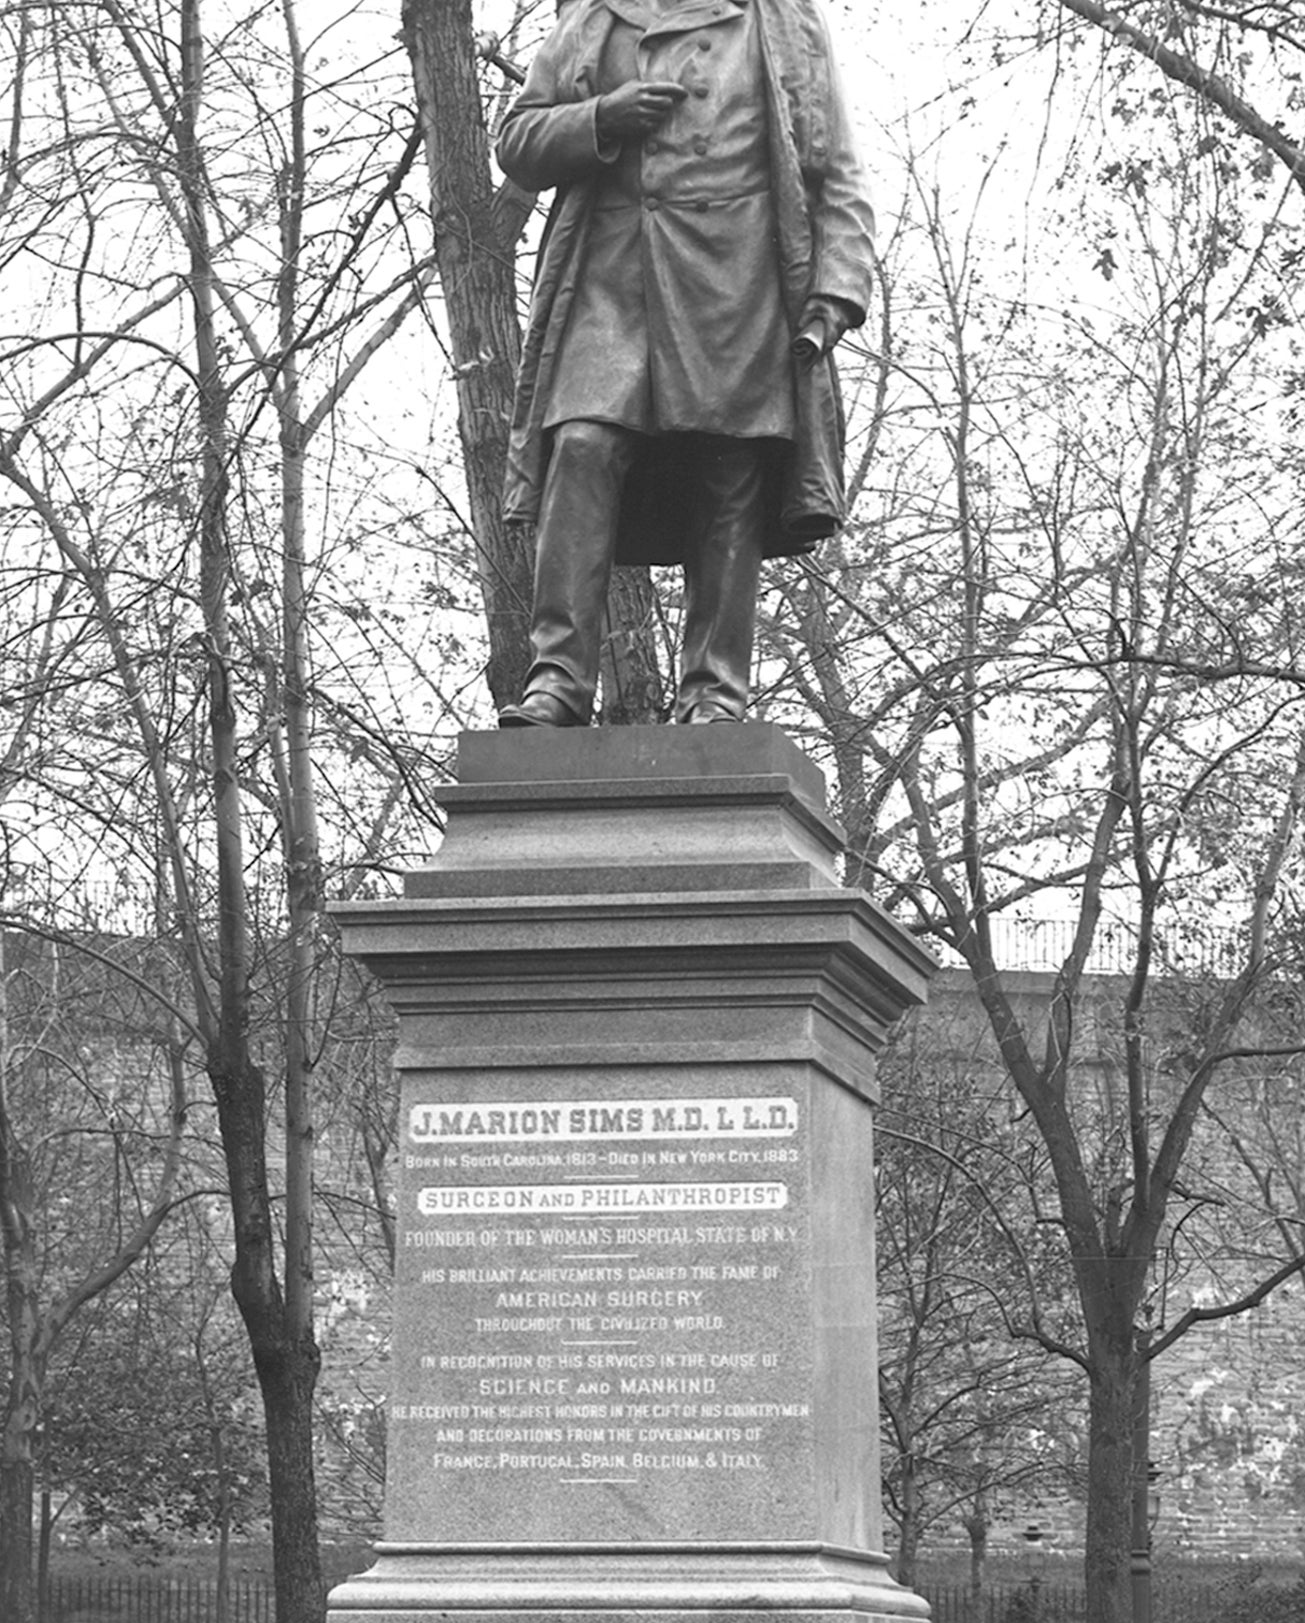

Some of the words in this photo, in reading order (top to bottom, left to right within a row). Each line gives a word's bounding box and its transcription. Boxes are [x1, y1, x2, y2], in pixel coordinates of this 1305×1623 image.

[569, 1108, 643, 1134] SIMS
[539, 1192, 575, 1207] AND
[581, 1186, 781, 1207] PHILANTHROPIST
[405, 1231, 476, 1247] FOUNDER
[480, 1230, 498, 1247] OF
[505, 1230, 535, 1246] THE
[540, 1228, 612, 1246] WOMAN'S
[616, 1227, 694, 1244] HOSPITAL
[696, 1227, 746, 1243] STATE
[751, 1227, 769, 1242] OF
[421, 1269, 445, 1283] HIS
[448, 1268, 516, 1283] BRILLIANT
[519, 1267, 622, 1283] ACHIEVEMENTS
[628, 1267, 686, 1281] CARRIED
[692, 1266, 717, 1280] THE
[722, 1266, 758, 1280] FAME
[762, 1265, 779, 1280] OF
[496, 1291, 597, 1307] AMERICAN
[570, 1317, 594, 1332] THE
[601, 1316, 668, 1331] CIVILIZED
[421, 1355, 435, 1368] IN
[537, 1355, 553, 1368] OF
[558, 1355, 582, 1368] HIS
[587, 1354, 656, 1368] SERVICES
[660, 1355, 676, 1367] IN
[680, 1355, 705, 1367] THE
[710, 1354, 756, 1367] CAUSE
[762, 1354, 779, 1367] OF
[479, 1378, 569, 1395] SCIENCE
[577, 1383, 610, 1395] AND
[391, 1406, 408, 1419] HE
[410, 1405, 469, 1419] RECEIVED
[473, 1405, 496, 1419] THE
[555, 1404, 607, 1418] HONORS
[610, 1404, 623, 1417] IN
[627, 1404, 650, 1417] THE
[682, 1404, 697, 1417] OF
[701, 1403, 722, 1417] HIS
[436, 1428, 464, 1443] AND
[469, 1428, 562, 1443] DECORATIONS
[567, 1427, 605, 1443] FROM
[608, 1427, 634, 1442] THE
[745, 1427, 763, 1442] OF
